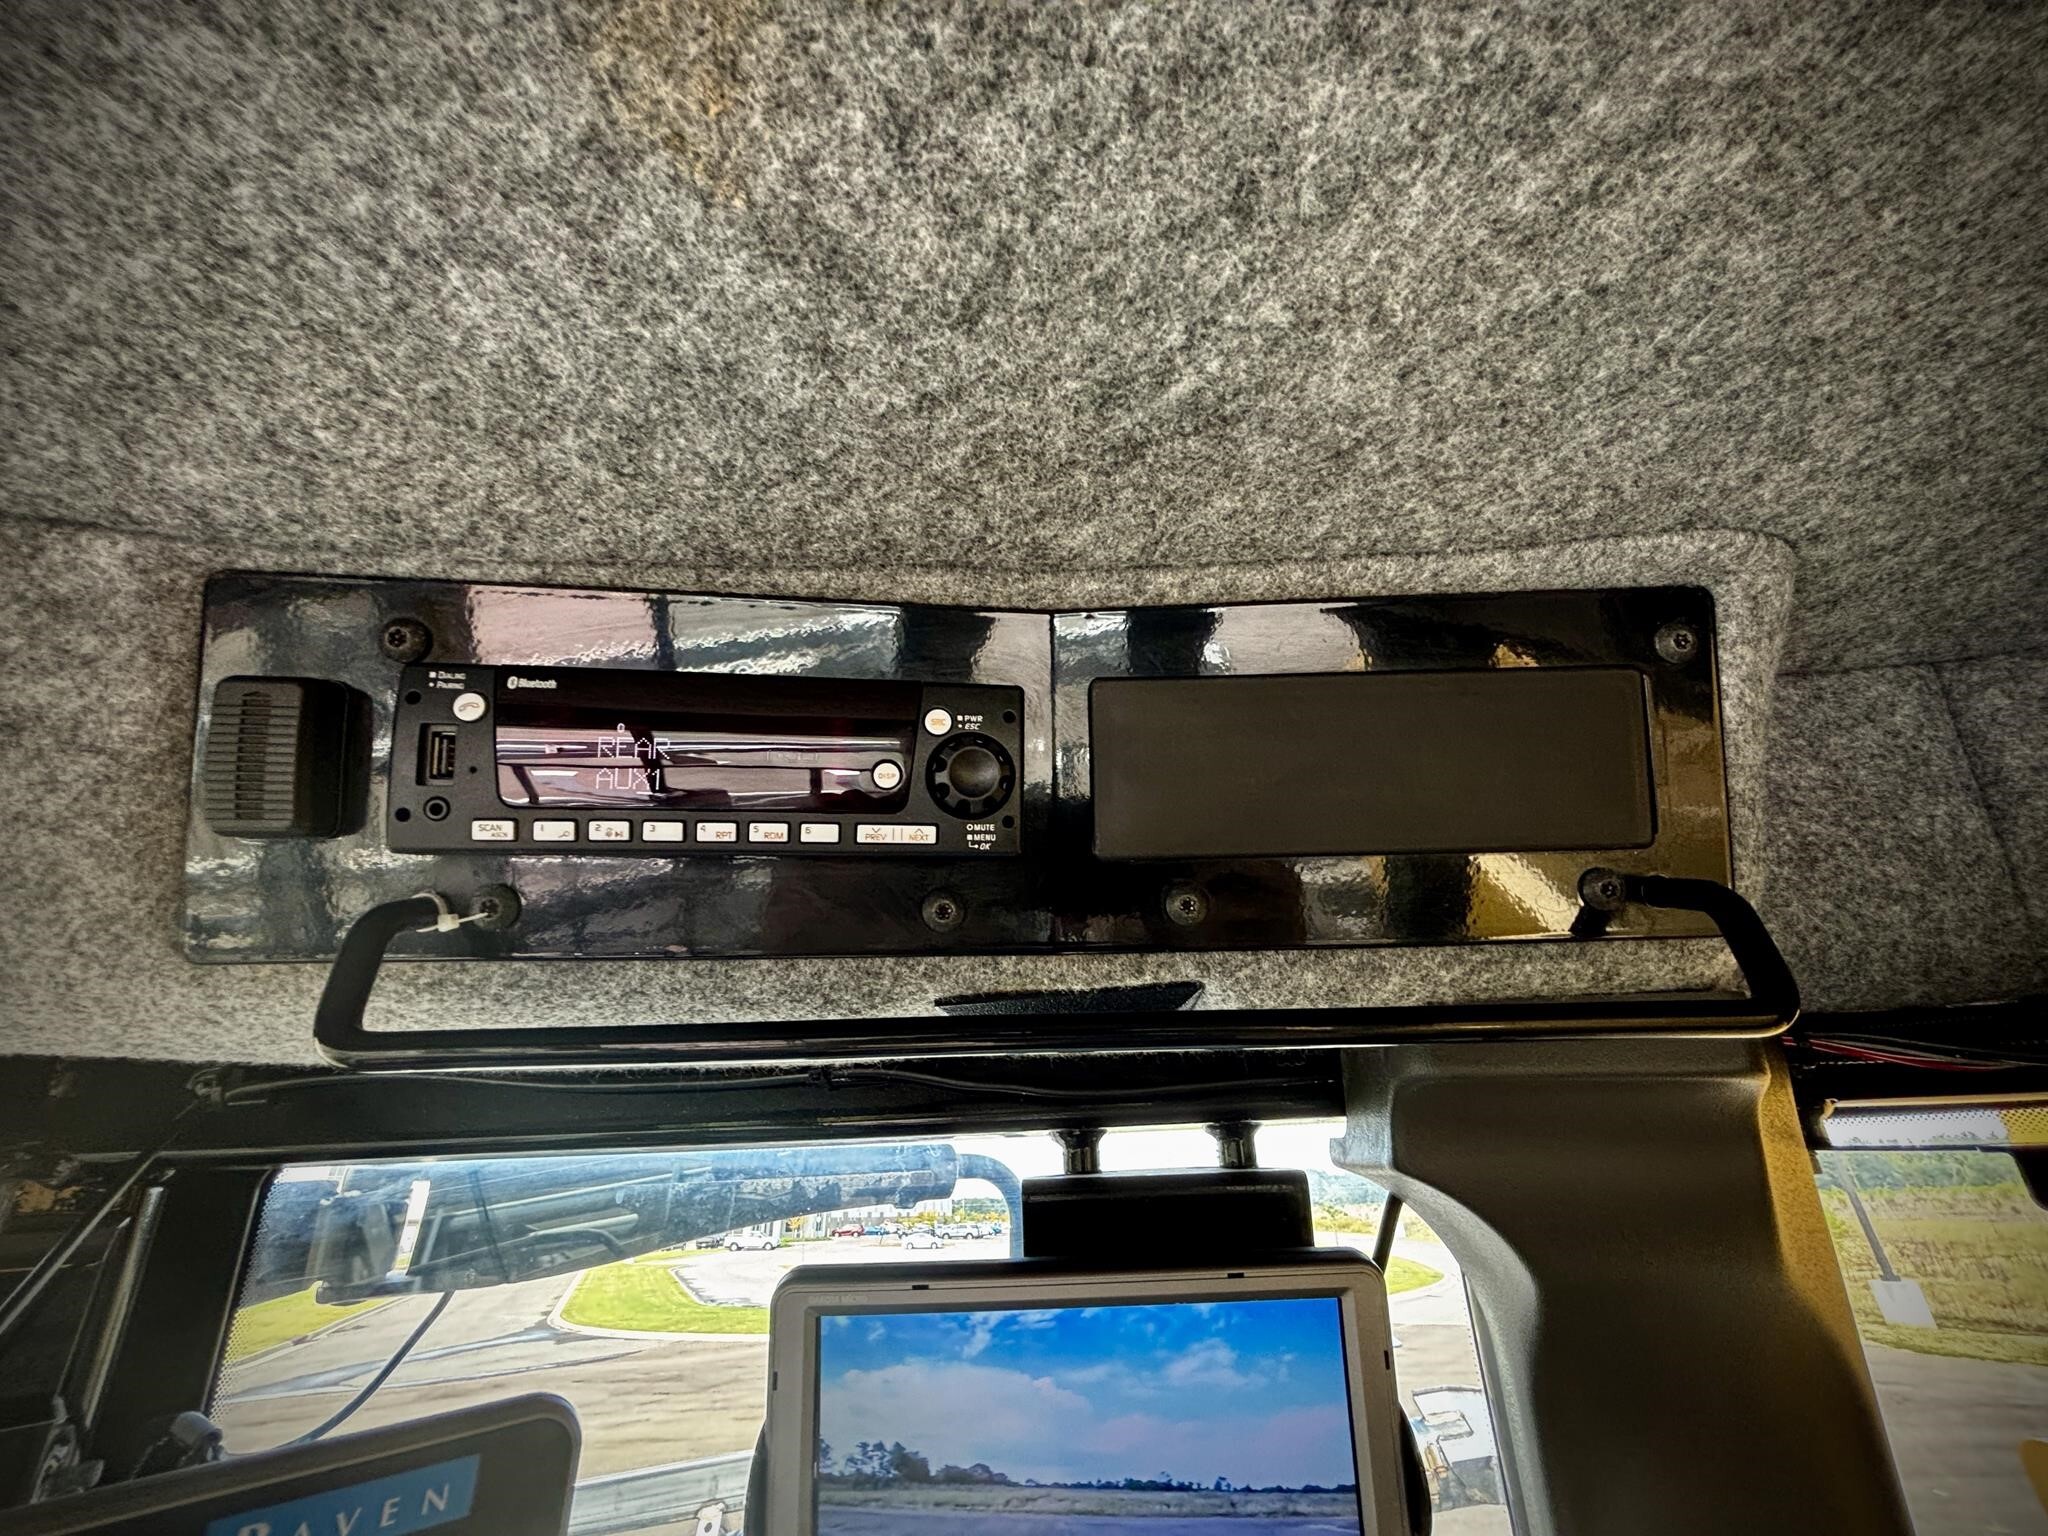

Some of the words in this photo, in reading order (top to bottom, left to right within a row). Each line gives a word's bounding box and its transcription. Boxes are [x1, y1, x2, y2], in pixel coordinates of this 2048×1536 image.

[597, 736, 670, 760] REAR
[596, 767, 660, 790] AUX1
[478, 824, 502, 832] SCAN
[649, 824, 656, 832] 3
[700, 824, 706, 832] 4
[753, 825, 759, 833] 5
[805, 826, 812, 834] 6
[974, 823, 995, 831] MUTE
[715, 831, 733, 840] RPT
[763, 832, 785, 840] RDM
[864, 833, 886, 841] PREV
[908, 833, 930, 841] NEXT
[979, 842, 992, 850] OK
